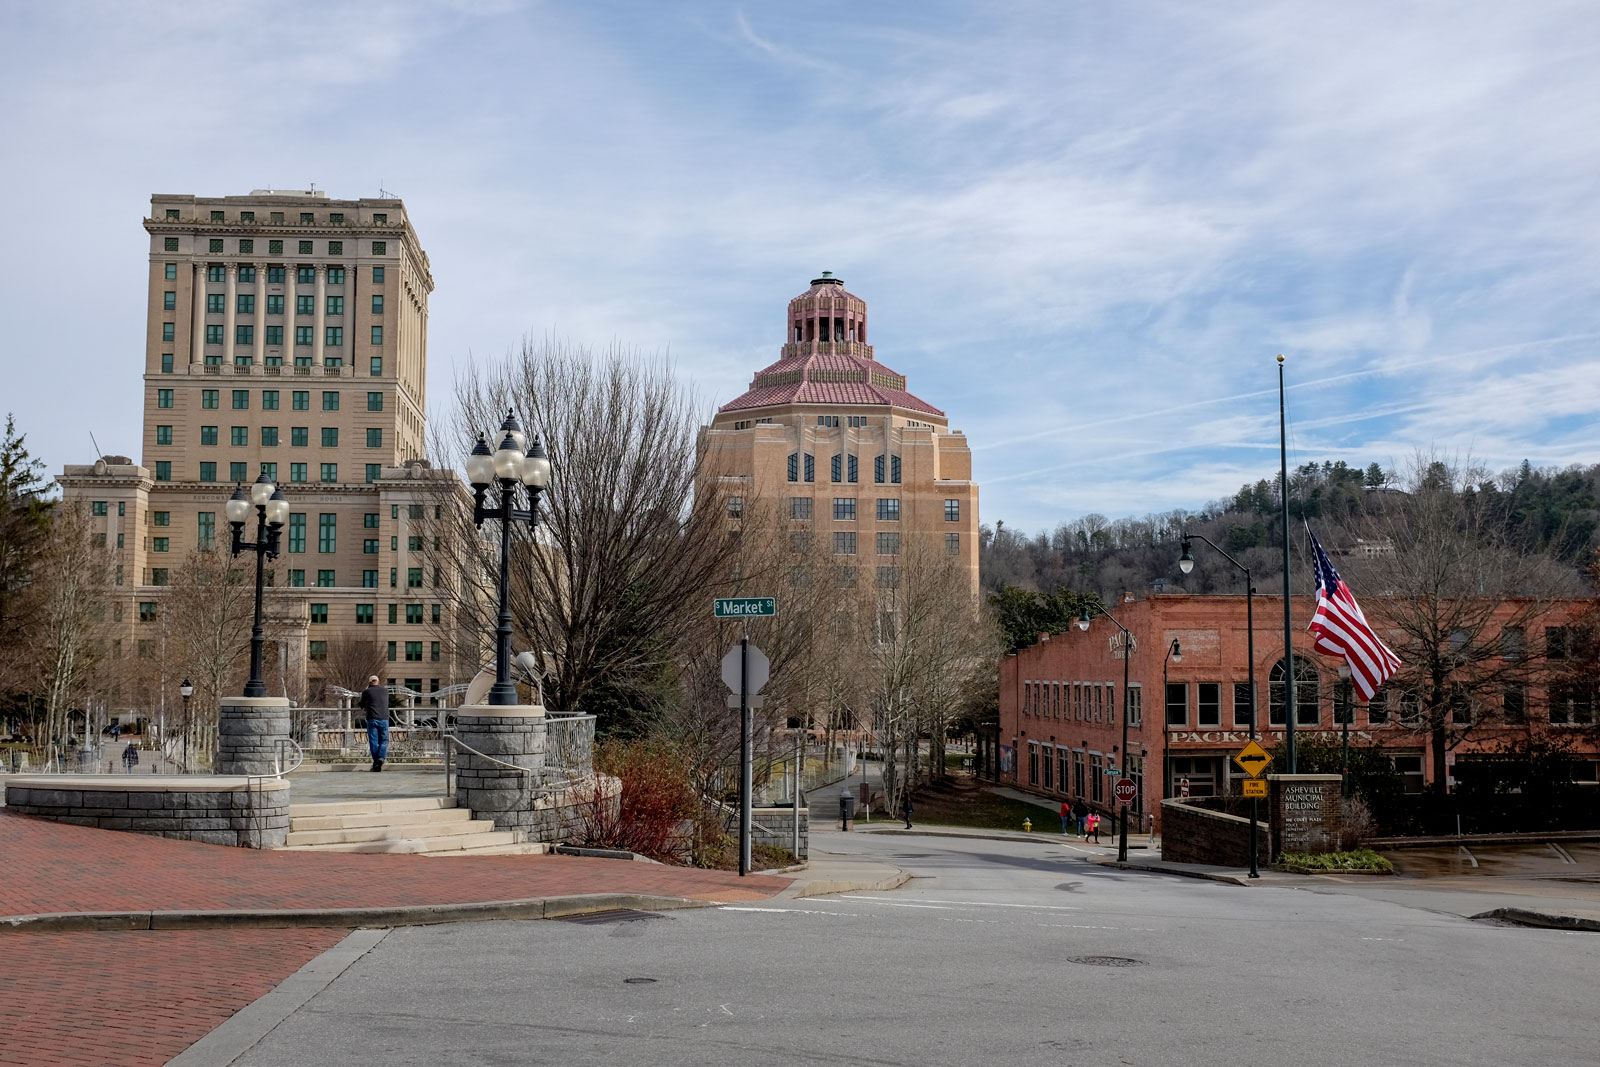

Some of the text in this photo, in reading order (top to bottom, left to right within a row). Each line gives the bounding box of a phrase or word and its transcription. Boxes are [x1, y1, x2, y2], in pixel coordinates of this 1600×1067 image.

[715, 601, 721, 609] S
[723, 600, 763, 614] Market
[1169, 731, 1263, 743] PACK'S
[1116, 785, 1136, 795] STOP
[1285, 802, 1320, 810] BUILDING
